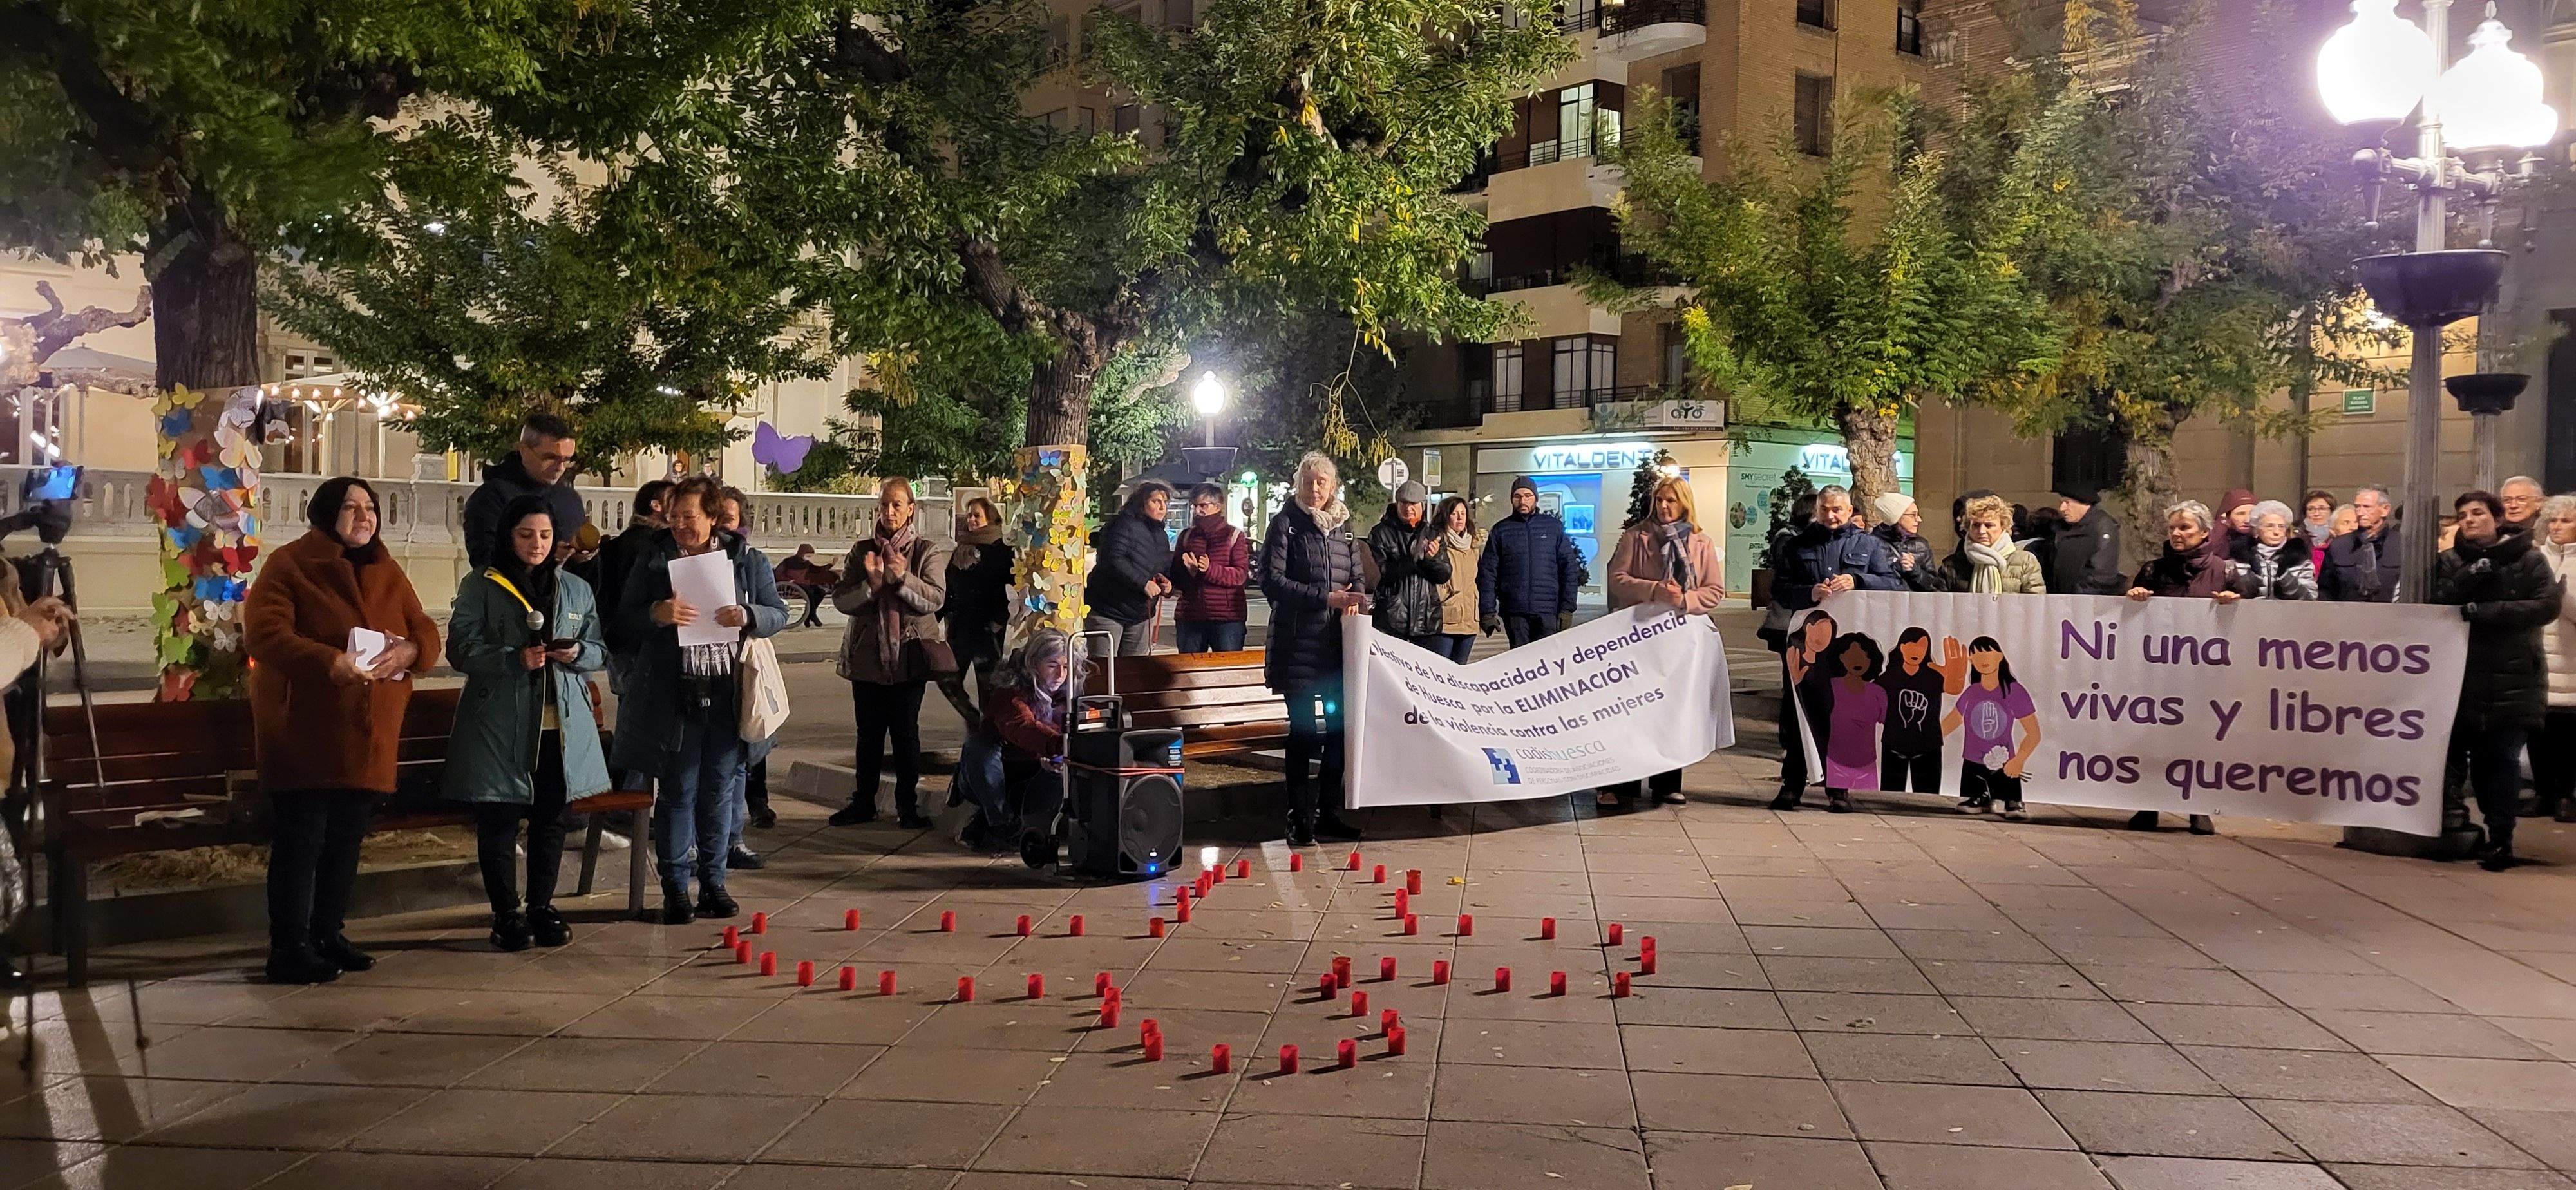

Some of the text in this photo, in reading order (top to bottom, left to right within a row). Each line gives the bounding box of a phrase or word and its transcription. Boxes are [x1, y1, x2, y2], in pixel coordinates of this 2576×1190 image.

[1533, 448, 1653, 469] VITALDENT
[1370, 612, 1687, 695] olectivo de la discapacidad y dependencia
[2061, 619, 2431, 675] Ni una menos
[1404, 686, 1665, 738] de la violencia contra las mujeres
[1405, 660, 1640, 716] de Huesca por la ELIMINACIÓN
[2061, 682, 2425, 741] vivas y libres
[1515, 741, 1607, 761] cadishuesca
[2059, 750, 2421, 806] nos queremos
